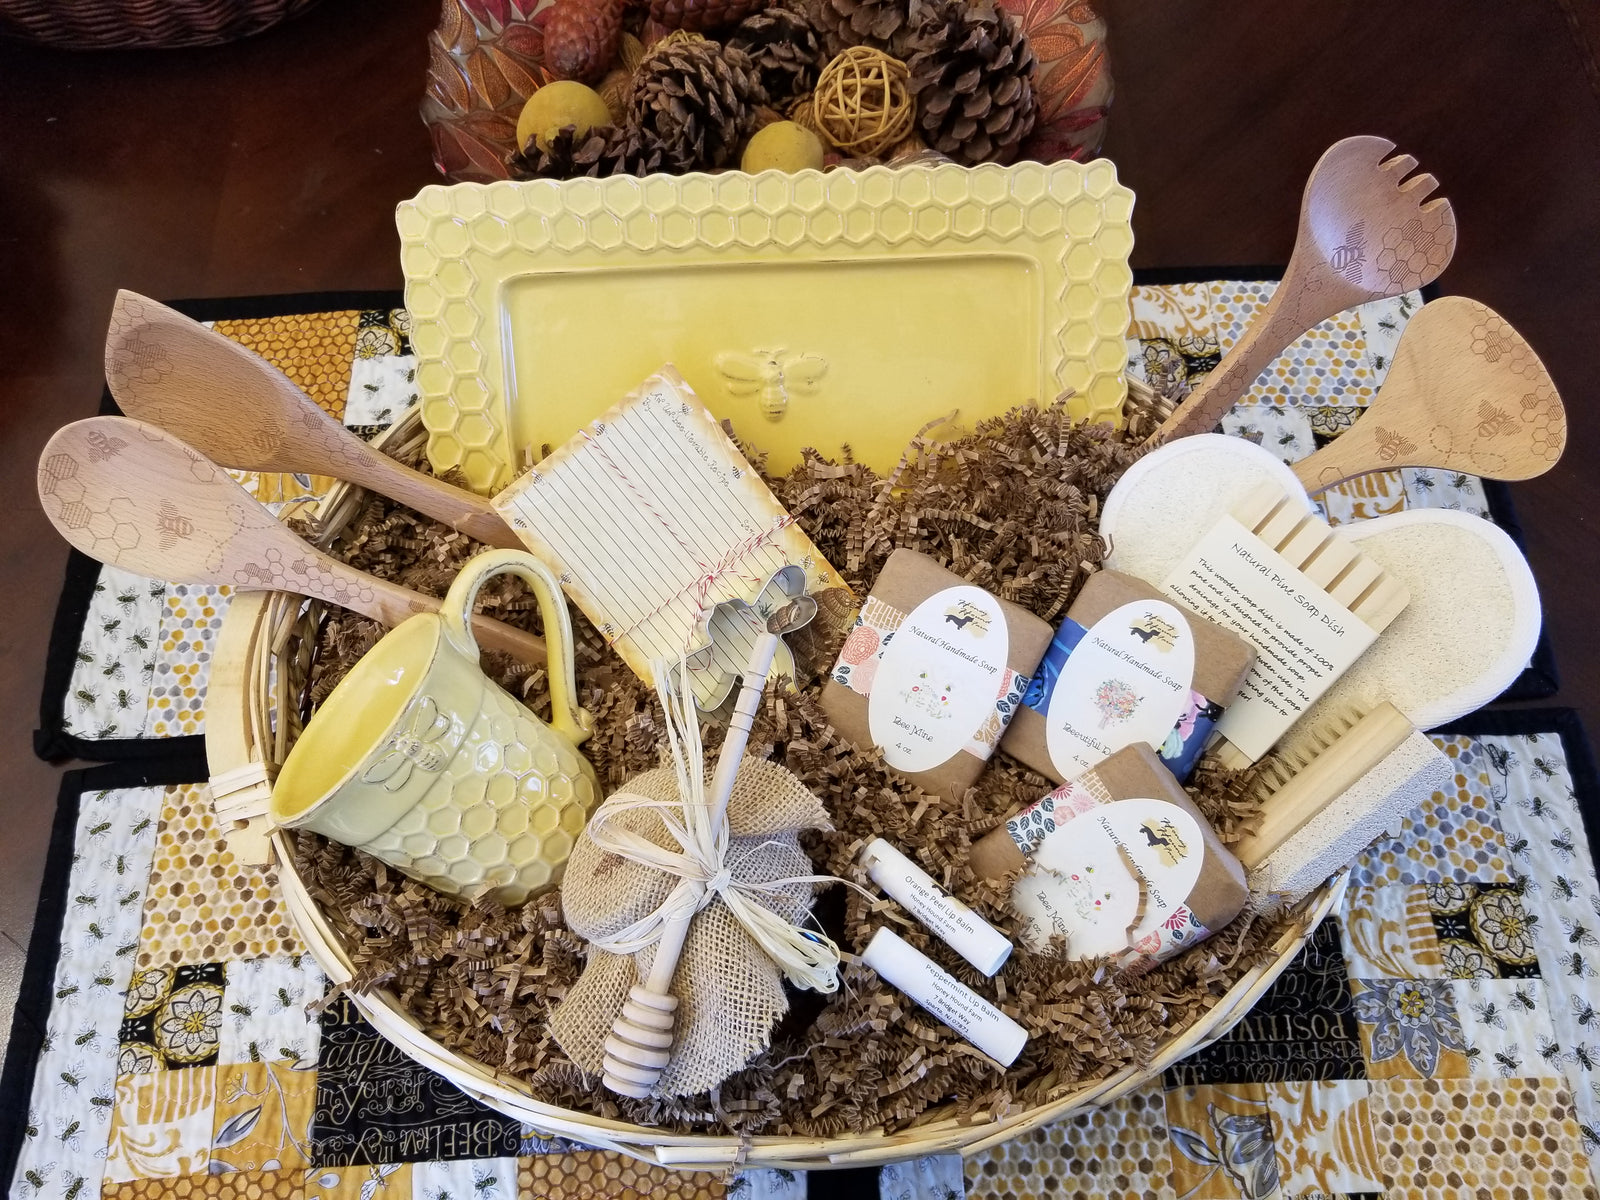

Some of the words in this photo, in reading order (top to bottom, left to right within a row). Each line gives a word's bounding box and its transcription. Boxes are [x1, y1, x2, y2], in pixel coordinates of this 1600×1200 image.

[708, 460, 730, 488] Recipe
[1169, 584, 1200, 610] allowing
[1231, 543, 1271, 576] Natural
[1270, 573, 1294, 595] Pine
[1293, 594, 1319, 618] Soap
[1320, 614, 1345, 637] Dish
[1188, 584, 1219, 609] drainage
[1218, 609, 1231, 618] for
[1230, 619, 1249, 633] your
[1248, 632, 1287, 666] handmade
[1190, 570, 1207, 583] pine
[1207, 584, 1223, 596] and
[1230, 602, 1262, 628] designed
[1268, 635, 1297, 658] provide
[1296, 658, 1323, 677] proper
[1198, 557, 1213, 572] This
[1214, 573, 1240, 594] wooden
[1240, 594, 1257, 608] soap
[1257, 608, 1274, 622] dish
[1283, 629, 1303, 646] made
[1303, 646, 1314, 654] of
[1312, 653, 1334, 671] 100%
[909, 625, 940, 645] Natural
[938, 639, 979, 664] Handmade
[978, 659, 998, 674] Soap
[1092, 636, 1124, 658] Natural
[1121, 652, 1163, 680] Handmade
[1162, 675, 1183, 691] Soap
[1253, 655, 1276, 674] tween
[1295, 687, 1309, 701] The
[1262, 678, 1272, 686] of
[1270, 685, 1283, 696] the
[1283, 696, 1301, 711] soap
[1262, 696, 1279, 709] you
[1278, 708, 1288, 716] to
[893, 716, 911, 730] Bee
[909, 723, 933, 743] Mine
[1036, 891, 1052, 911] Bee
[1150, 889, 1167, 909] Soap
